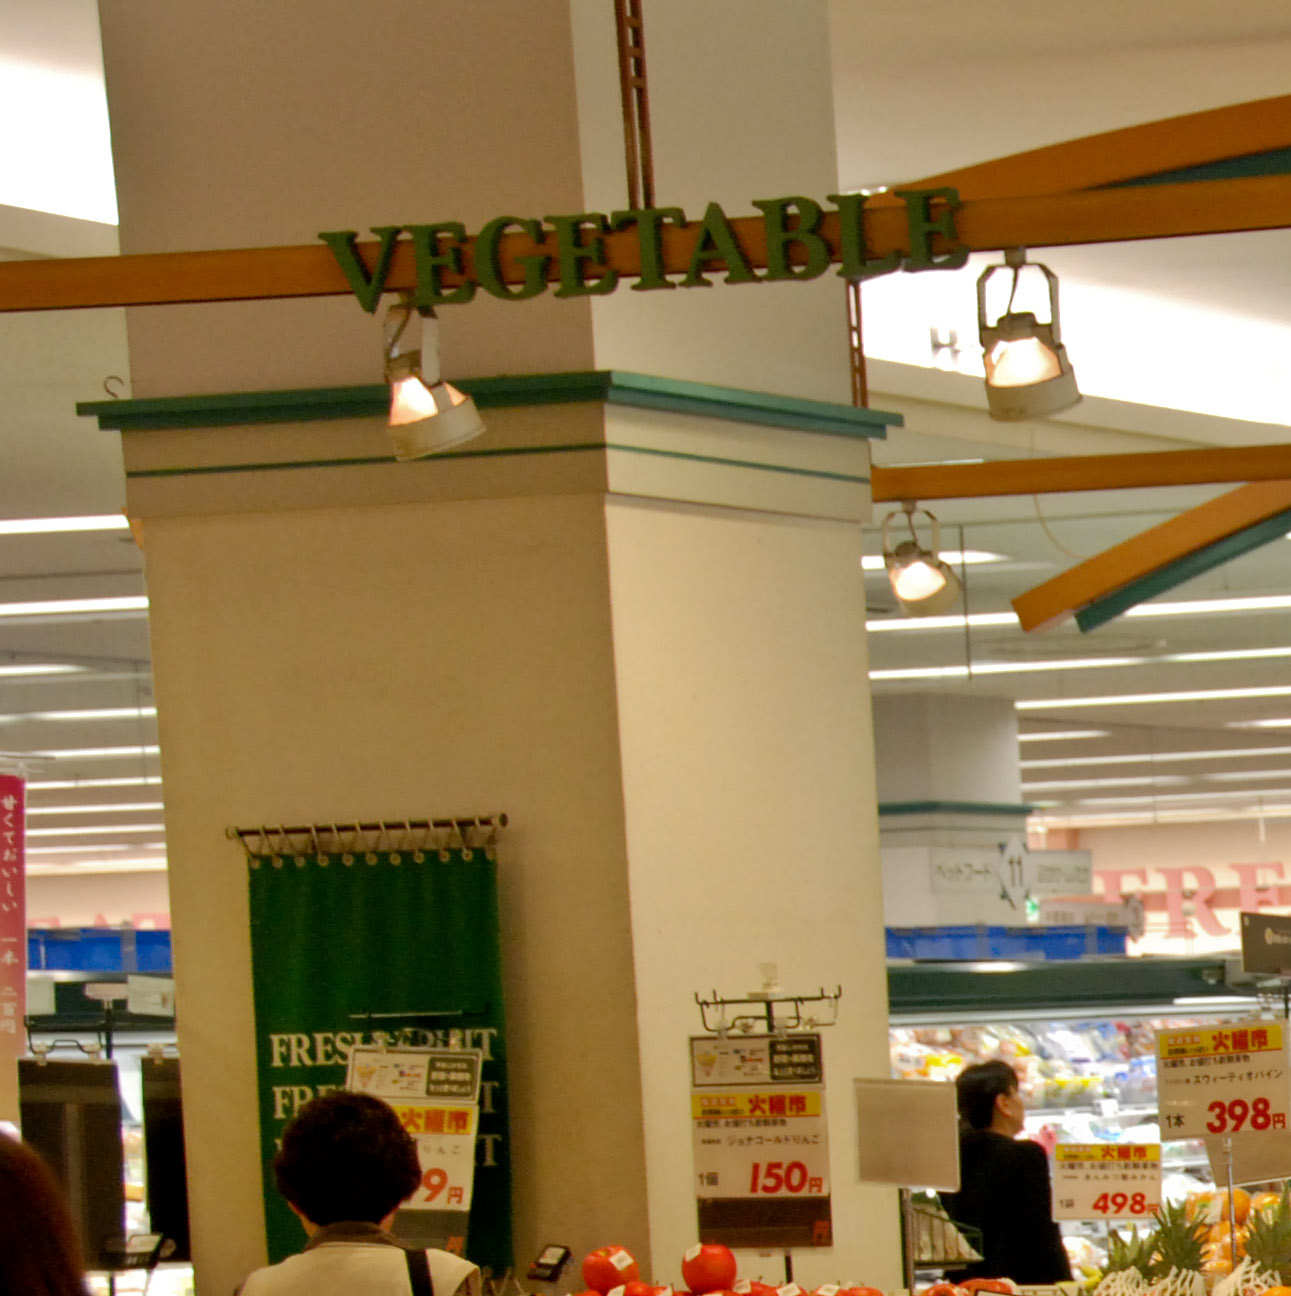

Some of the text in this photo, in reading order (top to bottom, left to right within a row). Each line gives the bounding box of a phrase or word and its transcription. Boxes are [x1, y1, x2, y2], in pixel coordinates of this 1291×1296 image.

[320, 187, 970, 313] VEGETABLE
[1212, 1029, 1268, 1052] 火曜市
[748, 1095, 807, 1115] 火曜市
[1166, 1097, 1286, 1134] 1本 398円
[400, 1108, 468, 1132] 火曜市
[421, 1168, 463, 1204] 9円
[699, 1161, 823, 1193] 1個 150円
[1092, 1192, 1158, 1216] 498円
